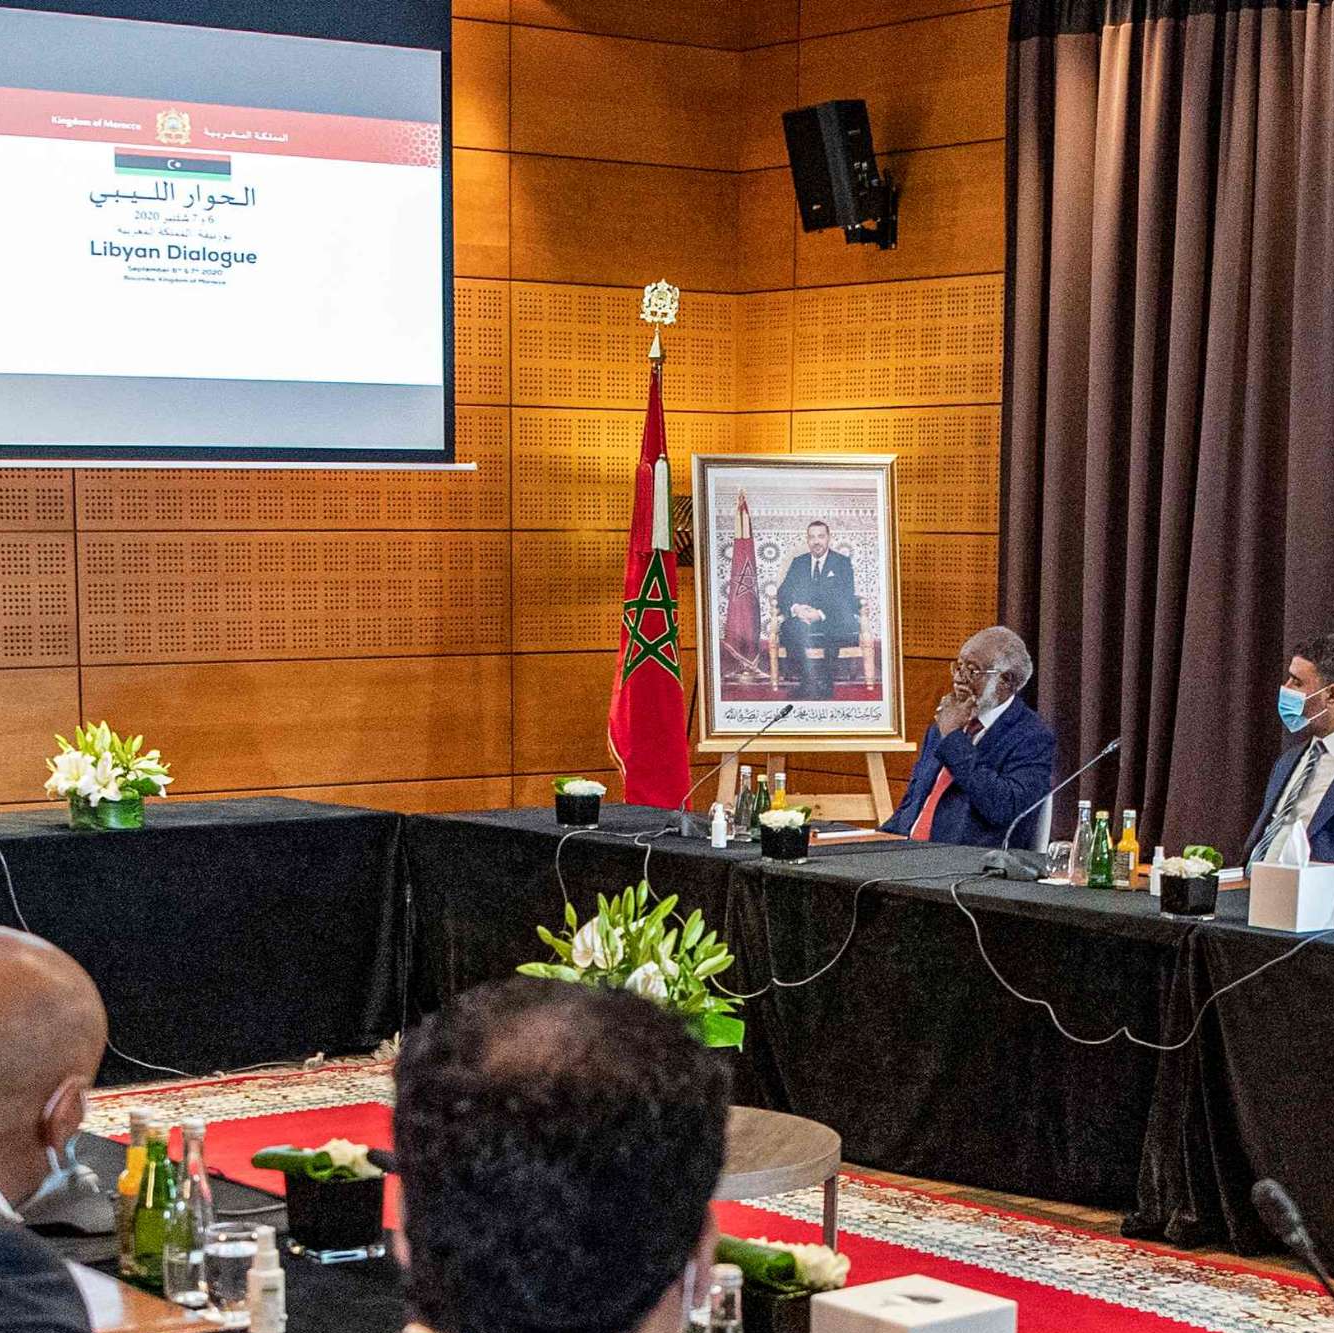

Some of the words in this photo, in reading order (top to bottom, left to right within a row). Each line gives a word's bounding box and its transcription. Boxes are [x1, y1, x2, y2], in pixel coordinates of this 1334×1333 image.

[51, 116, 91, 128] Kingdom
[92, 118, 102, 128] of
[103, 119, 141, 130] Morocco
[89, 180, 175, 208] الليبي
[183, 183, 256, 211] الحوار
[134, 210, 160, 221] 2020
[90, 240, 161, 262] Libyan
[167, 245, 258, 269] Dialogue
